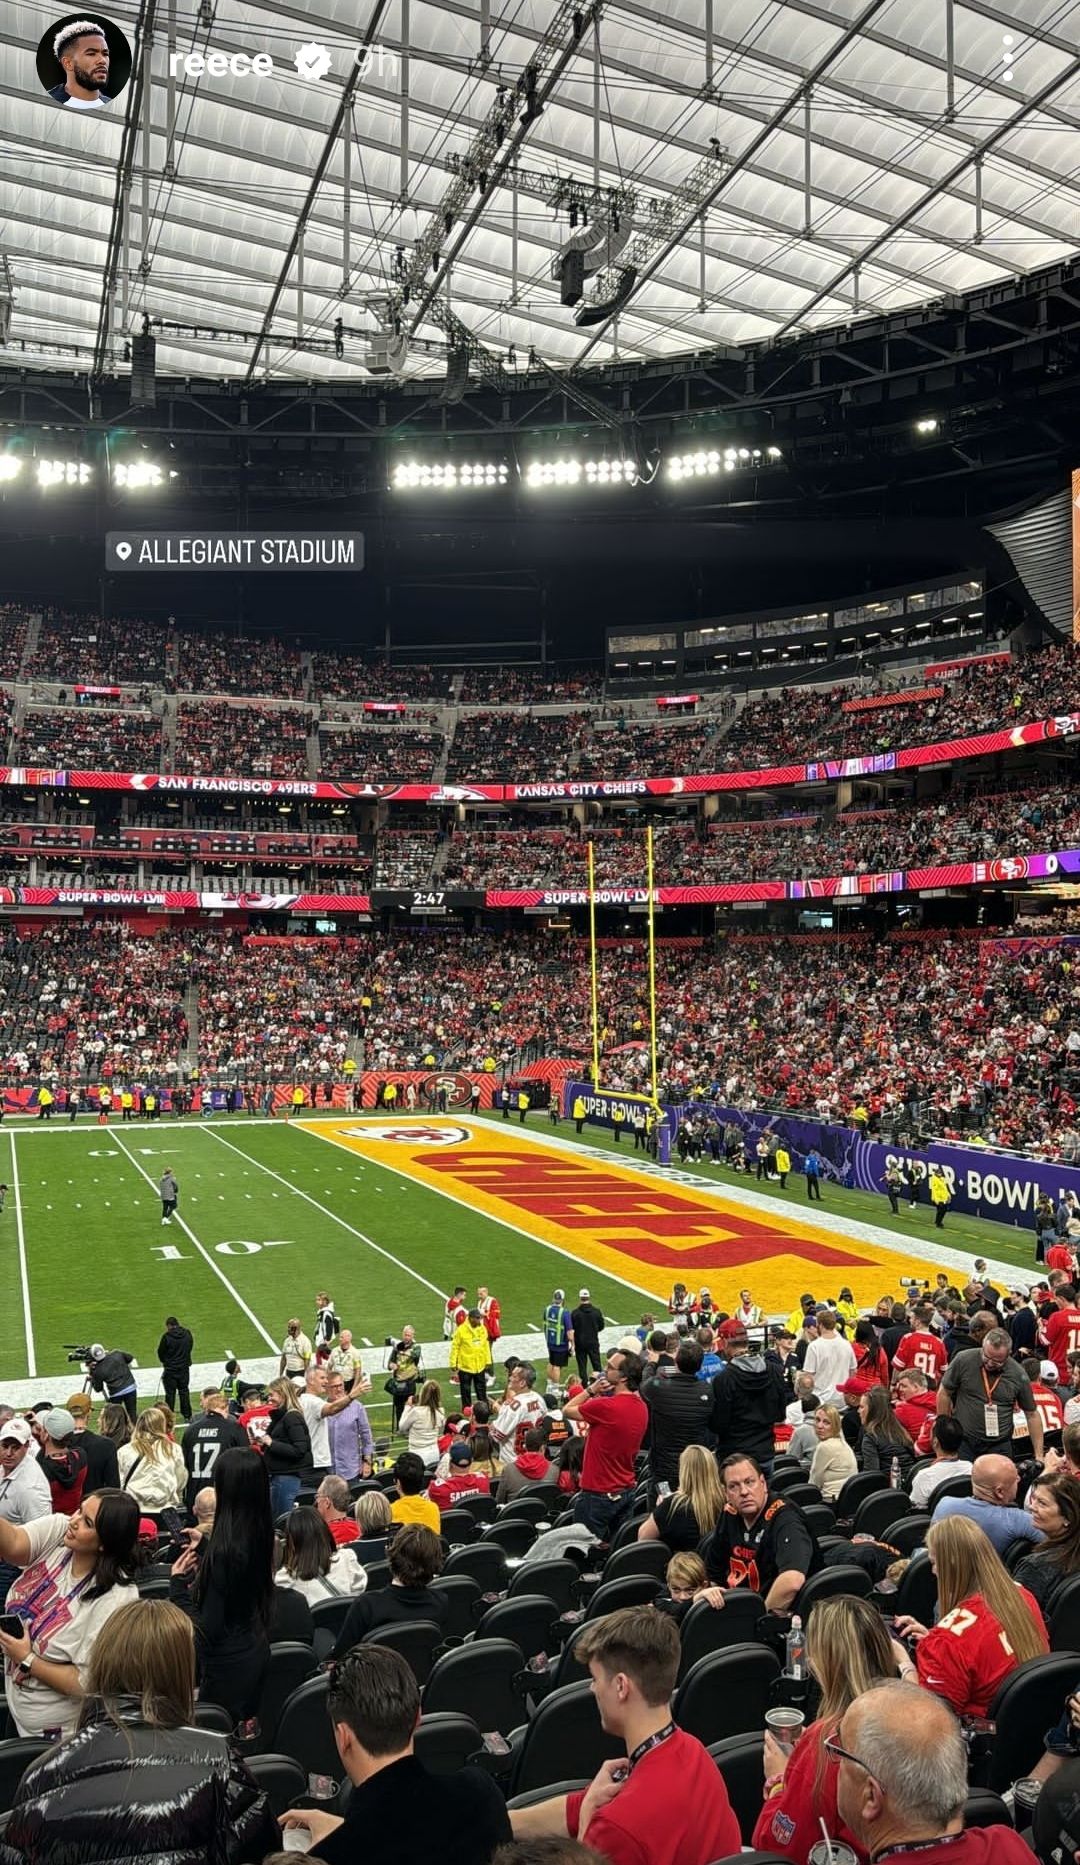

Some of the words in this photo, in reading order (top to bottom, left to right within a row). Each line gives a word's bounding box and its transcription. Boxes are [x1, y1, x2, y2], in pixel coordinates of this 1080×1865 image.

[158, 777, 187, 789] SAN
[192, 779, 272, 793] FRANCISCO
[278, 783, 318, 795] 49ERS
[514, 784, 565, 797] KANSAS
[569, 783, 598, 795] CITY
[603, 781, 646, 794] CHIEFS
[1045, 855, 1058, 873] 0
[58, 892, 98, 903] SUPER
[103, 893, 141, 904] BOWL
[413, 892, 445, 905] 2:47
[544, 892, 587, 904] SUPER
[591, 891, 630, 903] BOWL
[634, 890, 659, 902] LVII
[410, 1150, 888, 1270] CHIEFS
[914, 1352, 937, 1379] 91
[1036, 1404, 1062, 1433] 15
[198, 1428, 219, 1438] ADAMS
[192, 1443, 221, 1478] 17
